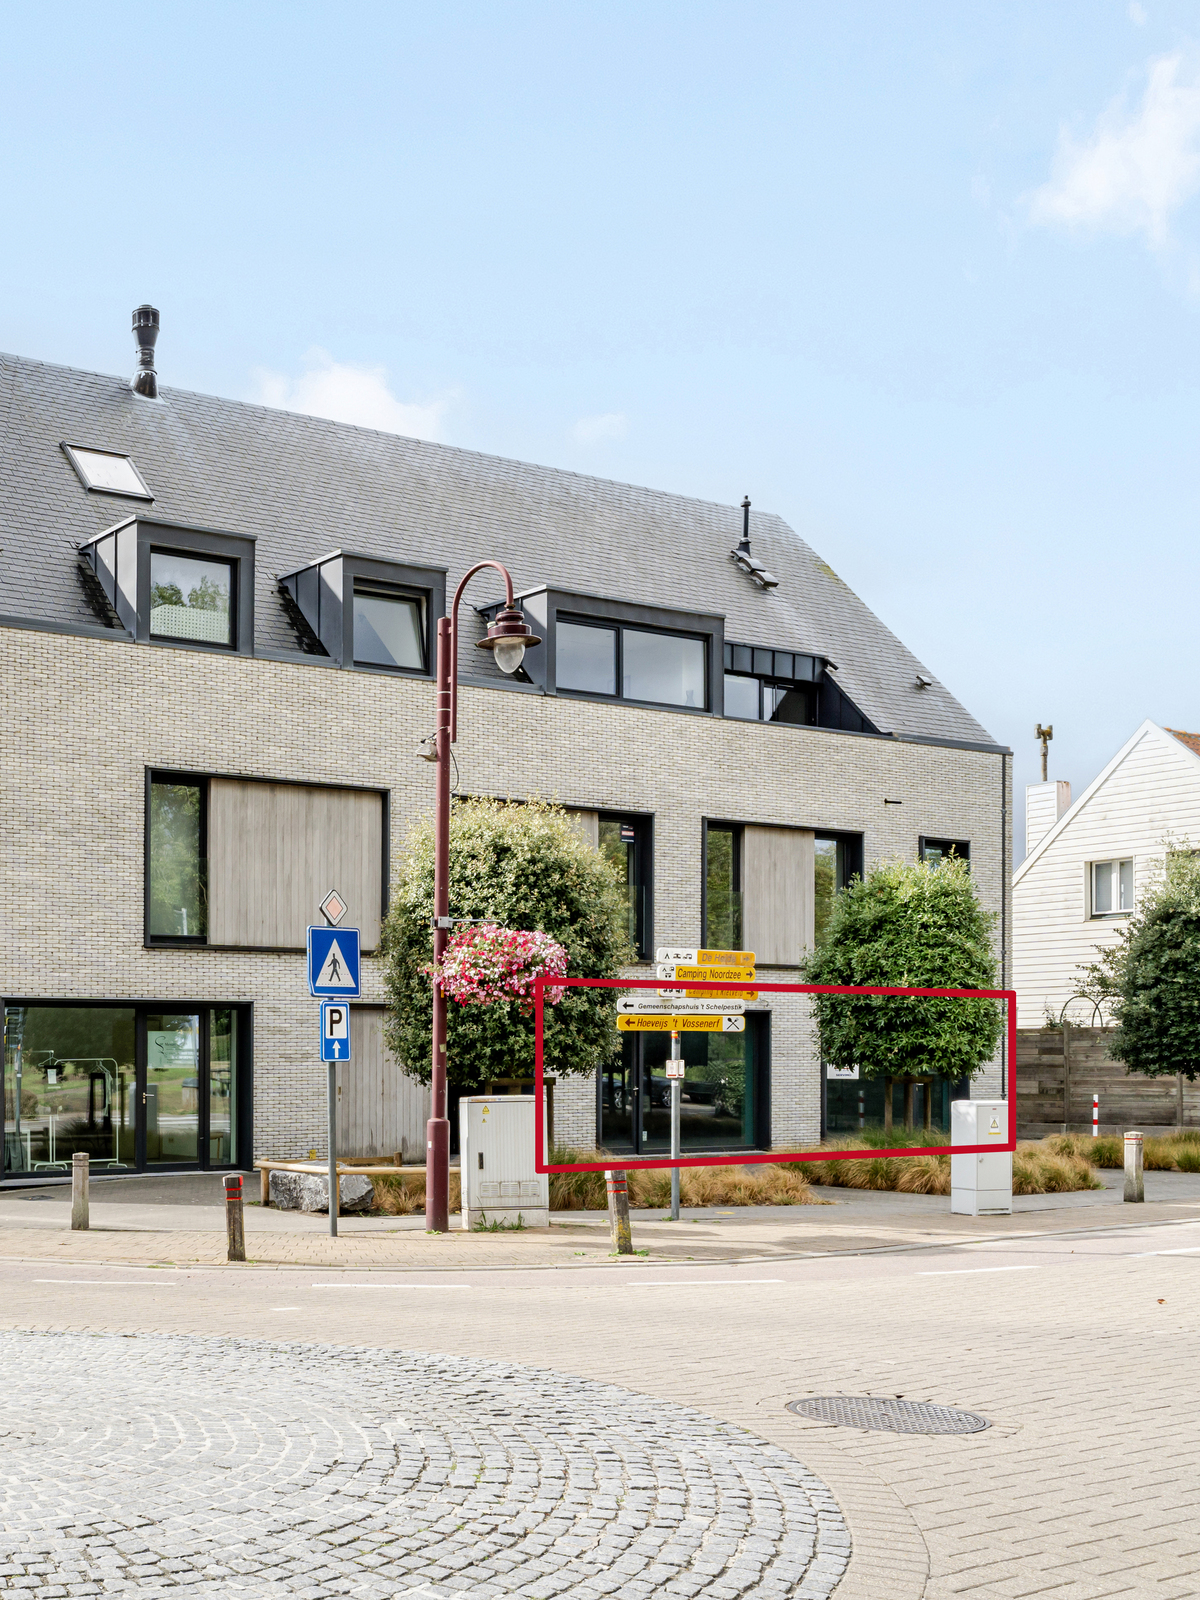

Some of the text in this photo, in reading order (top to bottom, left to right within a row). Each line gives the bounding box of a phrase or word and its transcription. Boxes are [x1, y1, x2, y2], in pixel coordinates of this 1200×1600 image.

[702, 953, 712, 962] De
[677, 968, 741, 981] Camping Noordzee
[638, 1003, 699, 1011] Gemeenschapshuis
[705, 1003, 742, 1011] Schelpestik
[329, 1008, 342, 1036] P
[636, 1018, 720, 1030] Hoeveijs 't Vossenerf
